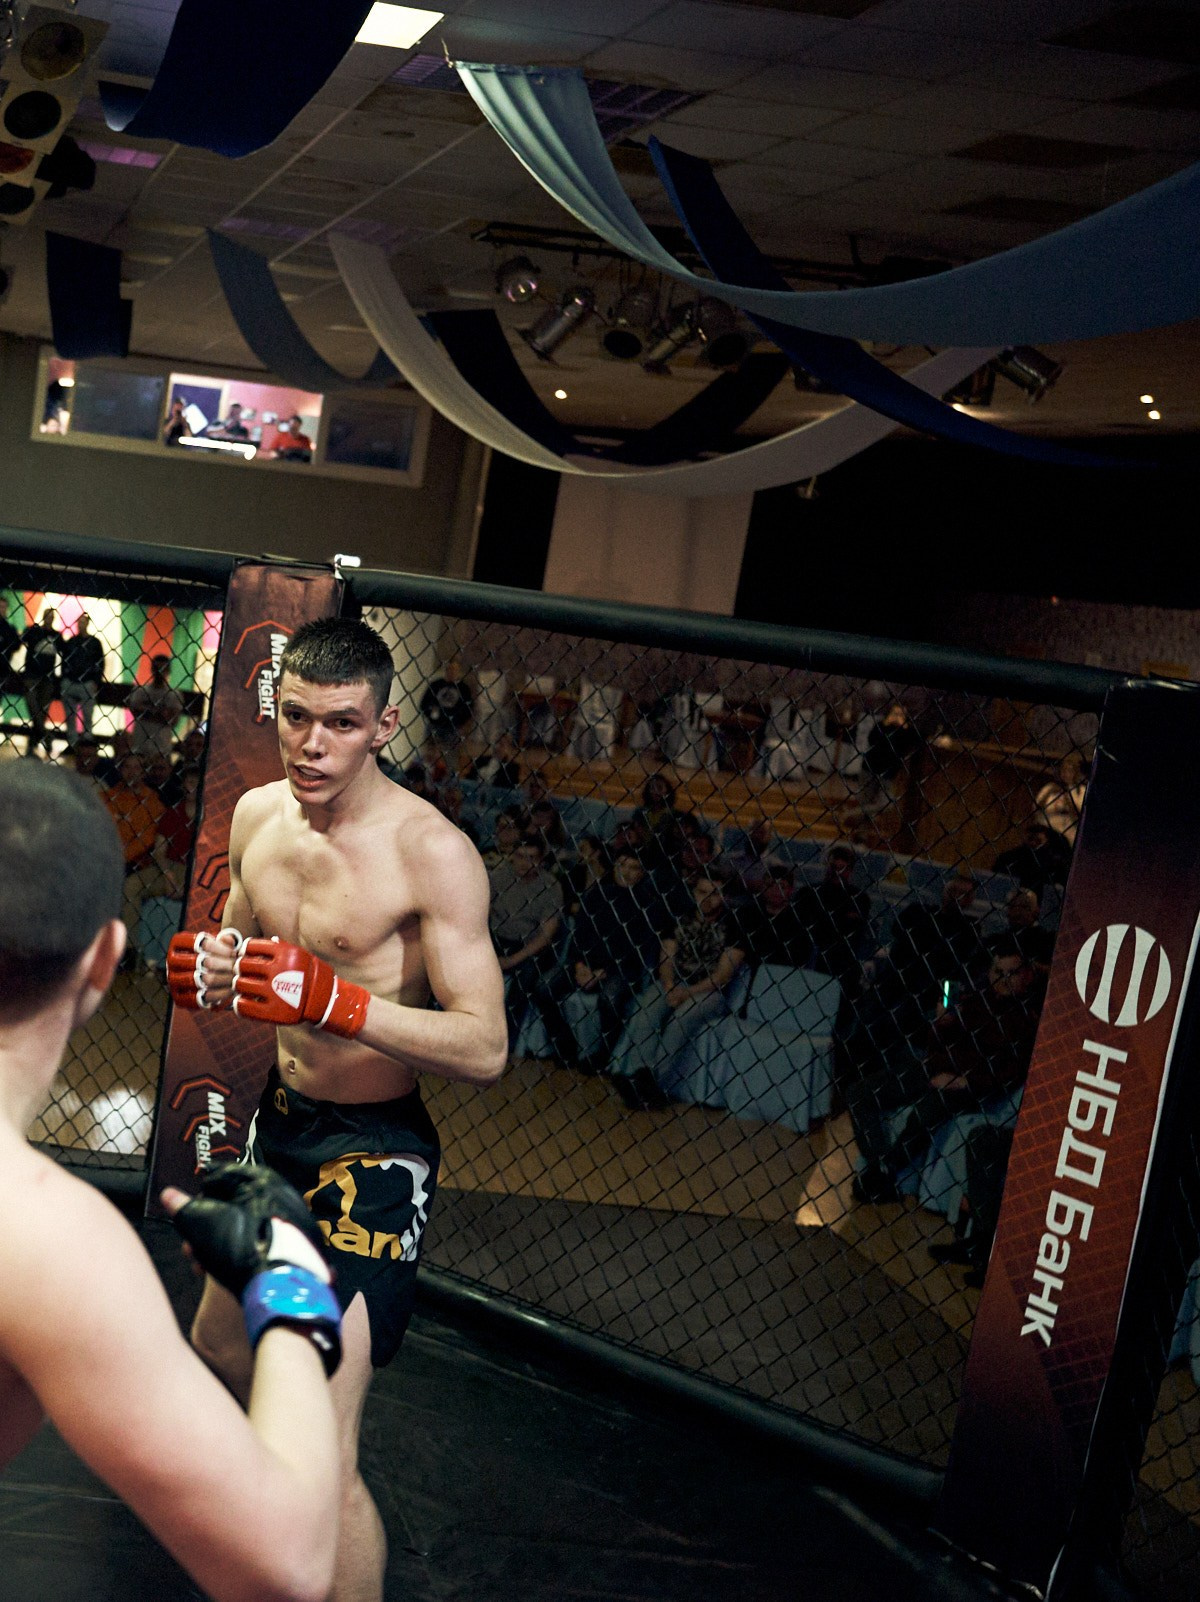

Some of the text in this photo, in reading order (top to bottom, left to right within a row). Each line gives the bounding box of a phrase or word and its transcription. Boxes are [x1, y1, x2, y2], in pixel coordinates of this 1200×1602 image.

[260, 669, 276, 720] FIGHT
[207, 1091, 227, 1136] MIX
[1020, 1039, 1128, 1347] НБД Банк
